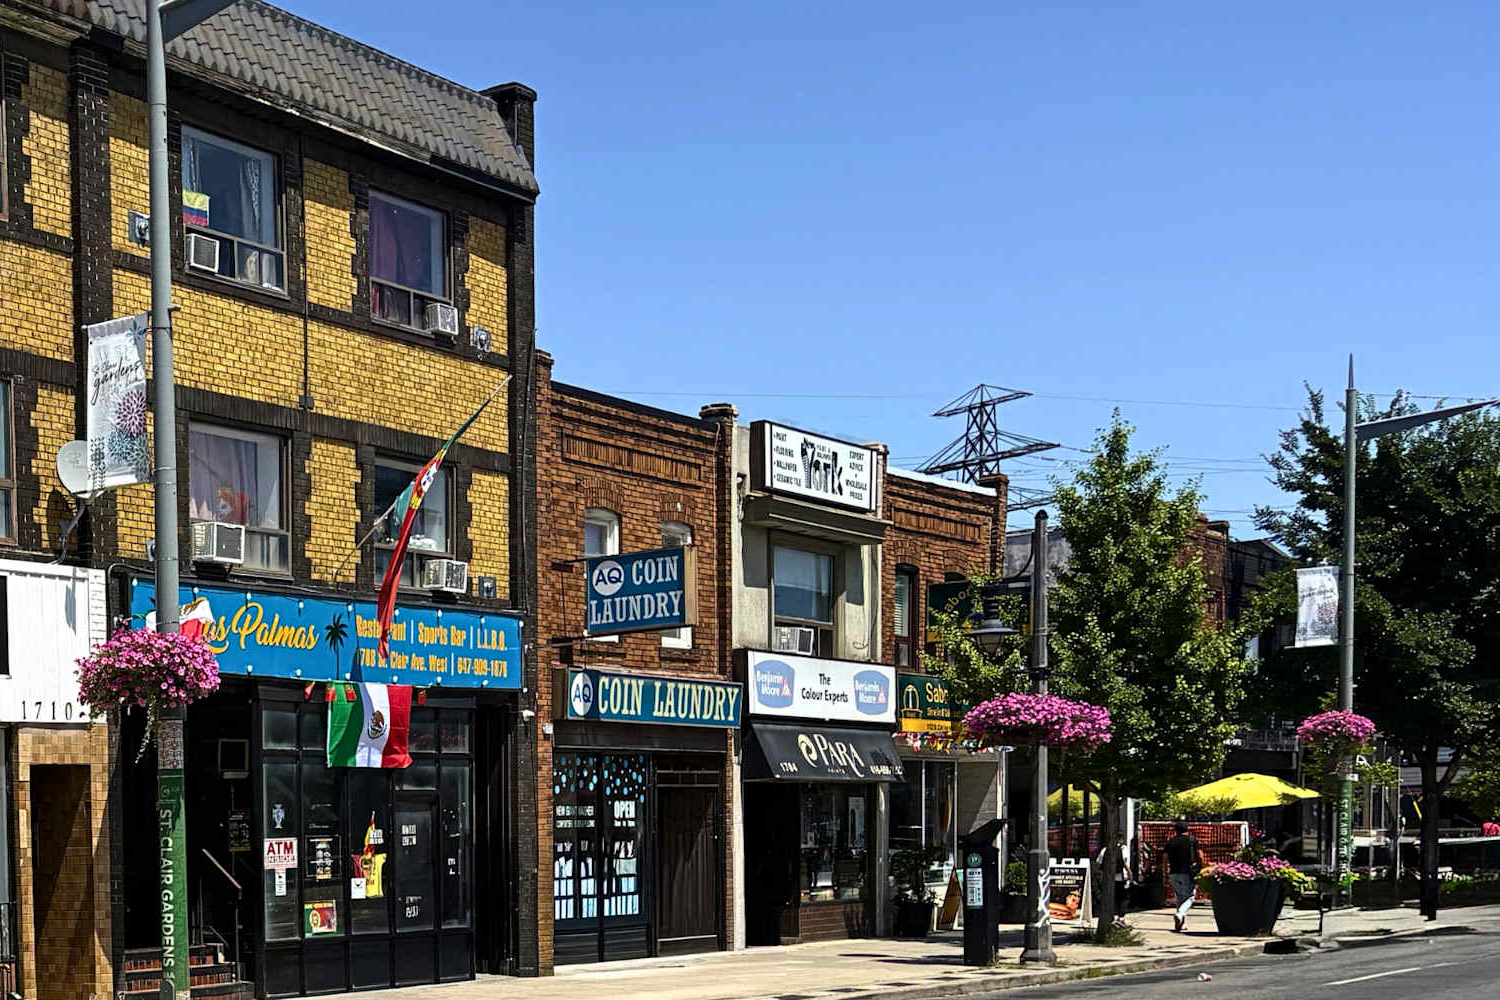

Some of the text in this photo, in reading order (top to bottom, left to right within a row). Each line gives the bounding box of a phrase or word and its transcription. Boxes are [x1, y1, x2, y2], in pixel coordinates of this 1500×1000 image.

[91, 355, 142, 406] gardens
[801, 440, 843, 496] York
[595, 555, 679, 586] AQ COIN
[590, 590, 683, 625] LAUNDRY
[944, 587, 971, 612] abor
[231, 602, 320, 650] Palmas
[418, 621, 448, 647] Sports
[450, 625, 467, 647] Bar
[390, 651, 409, 669] Clair
[411, 653, 428, 671] Ave.
[429, 654, 447, 672] West
[762, 685, 781, 696] Moore
[819, 673, 831, 685] The
[573, 674, 739, 722] AQ COIN LAUNDRY
[801, 687, 849, 704] Colour Experts
[22, 700, 73, 720] 1710
[813, 734, 865, 777] PARA
[614, 800, 636, 819] OPEN
[267, 842, 294, 855] ATM
[159, 808, 176, 968] ST. CLAIR GARDENS
